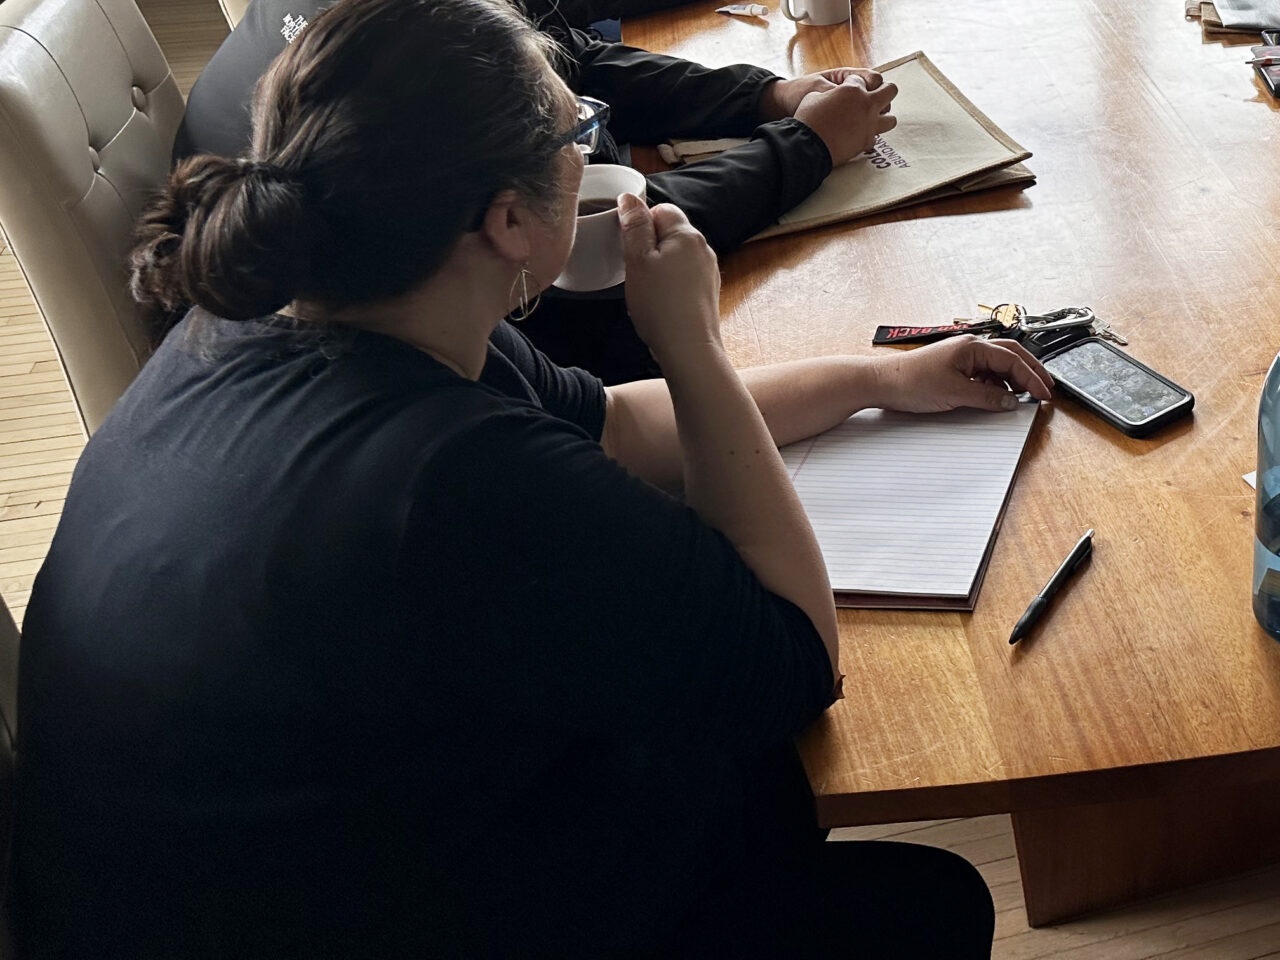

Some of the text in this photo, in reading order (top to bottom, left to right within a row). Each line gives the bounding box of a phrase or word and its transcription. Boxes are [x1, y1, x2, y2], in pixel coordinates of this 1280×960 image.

[294, 14, 309, 30] THE
[279, 25, 297, 44] FACE
[886, 327, 932, 339] BACK
